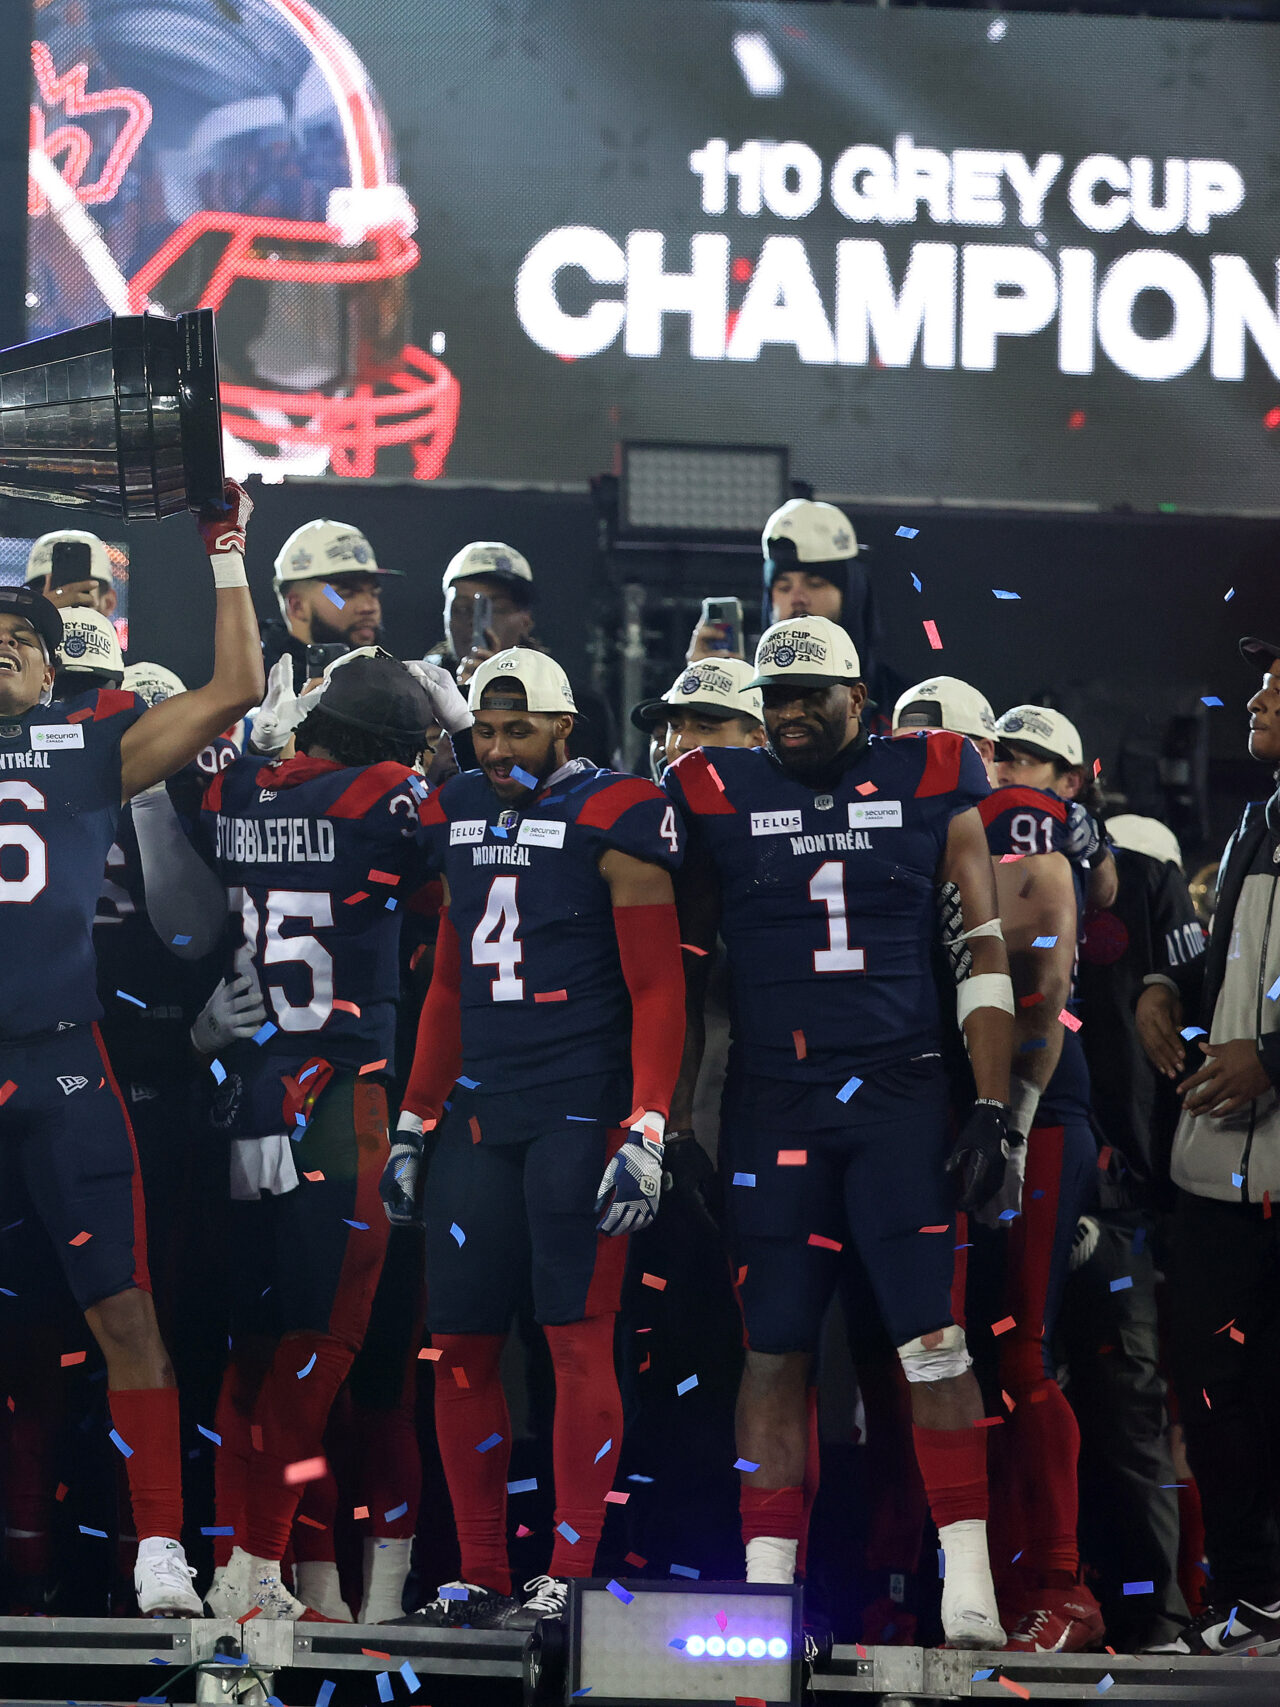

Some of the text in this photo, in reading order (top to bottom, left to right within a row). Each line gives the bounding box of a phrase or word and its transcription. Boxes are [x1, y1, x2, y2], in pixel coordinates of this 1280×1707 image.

[688, 132, 1245, 235] 110 GREY CUP
[88, 646, 100, 655] 23
[797, 654, 811, 662] 23
[451, 826, 484, 838] TELUS
[530, 826, 560, 835] securian
[660, 806, 678, 852] 4
[752, 816, 800, 829] TELUS
[1010, 813, 1054, 856] 91
[790, 829, 873, 855] MONTRÉAL
[472, 843, 531, 866] MONTRÉAL
[807, 859, 866, 973] 1
[471, 874, 525, 1002] 4
